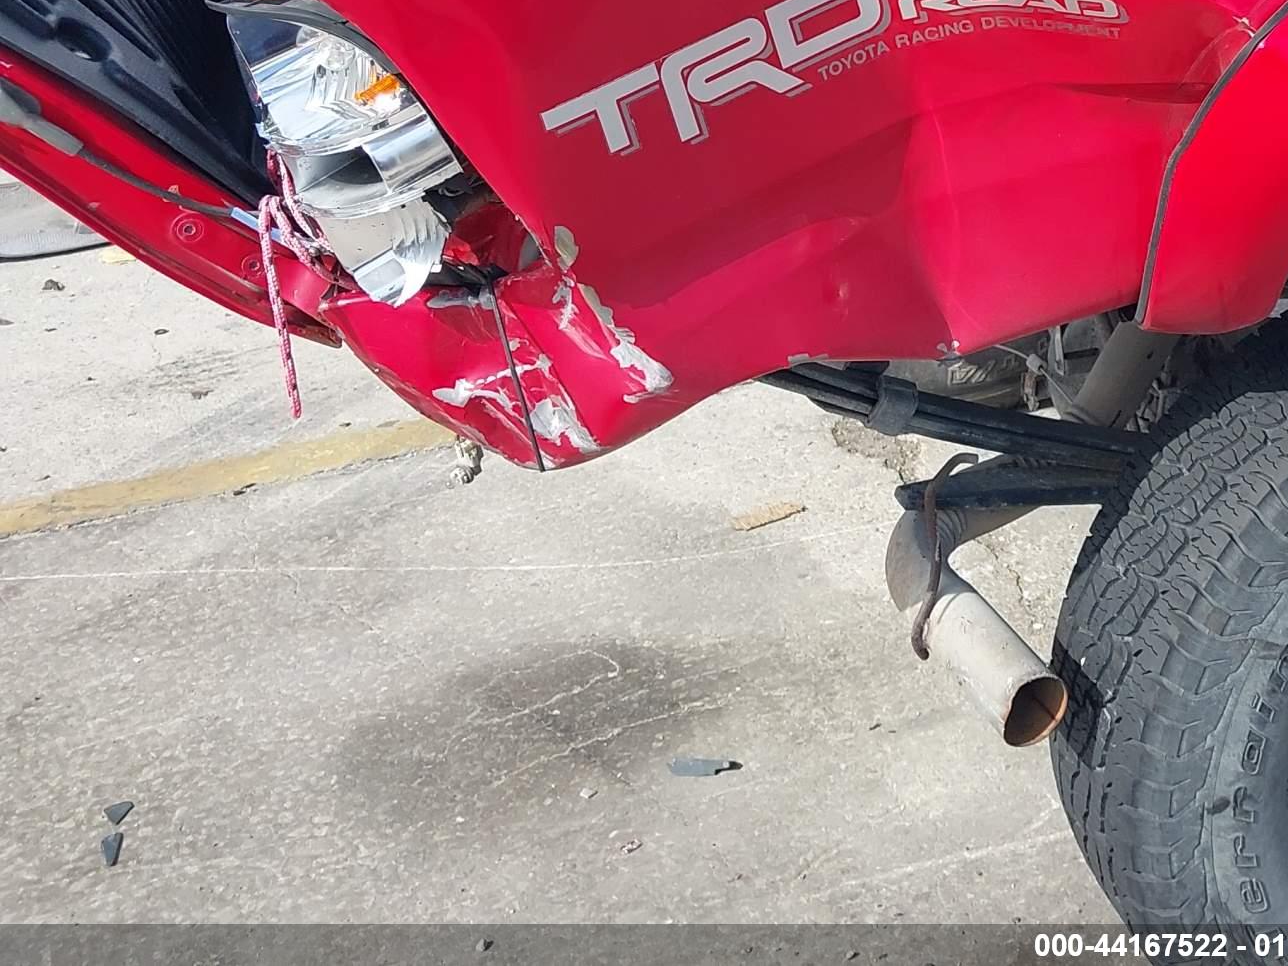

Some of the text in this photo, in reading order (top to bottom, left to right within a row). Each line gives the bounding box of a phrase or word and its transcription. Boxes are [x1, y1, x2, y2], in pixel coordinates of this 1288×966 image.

[817, 16, 1121, 81] TOYOTA RACING DEVELOPMENT
